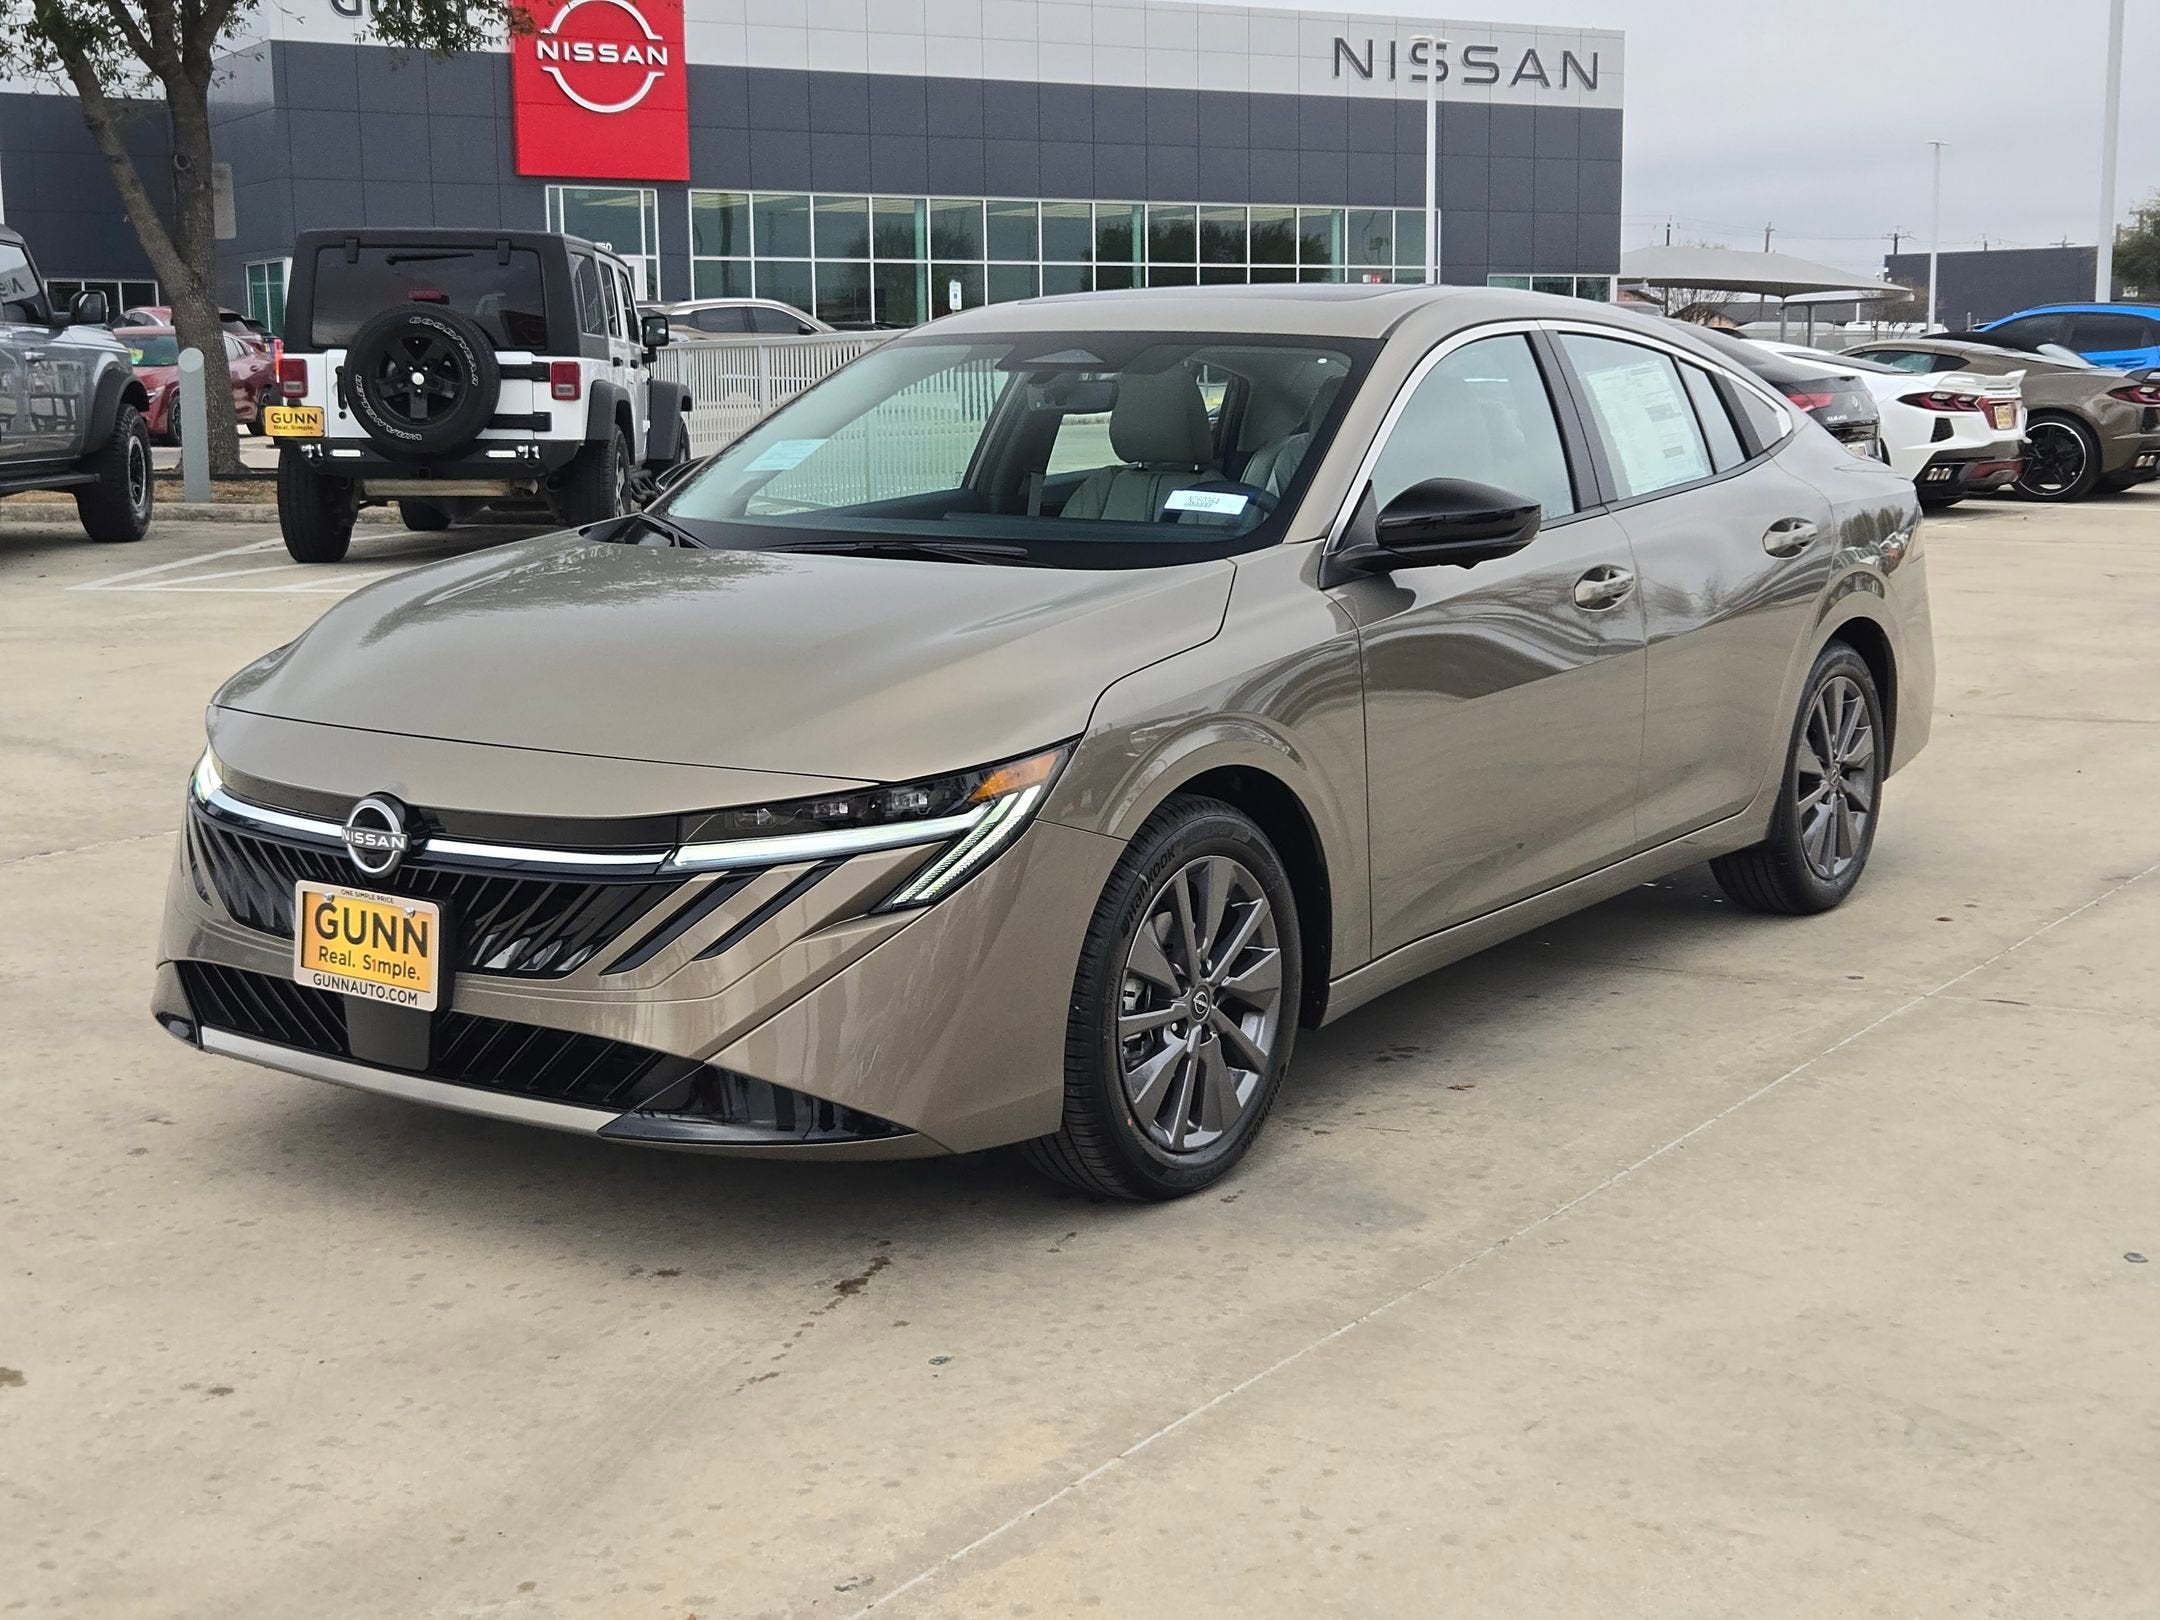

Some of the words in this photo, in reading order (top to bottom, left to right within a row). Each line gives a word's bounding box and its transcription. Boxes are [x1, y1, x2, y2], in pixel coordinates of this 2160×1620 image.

[537, 40, 668, 66] NISSAN
[1332, 37, 1599, 91] NISSAN
[409, 316, 478, 386] GOODYEAR
[270, 412, 318, 425] GUNN
[341, 827, 405, 849] NISSAN
[341, 888, 354, 897] ONE
[355, 891, 376, 900] SIMPLE
[376, 895, 395, 904] PRICE
[314, 901, 428, 958] GUNN
[318, 945, 356, 968] Real.
[313, 973, 418, 1006] GUNNAUTO.COM
